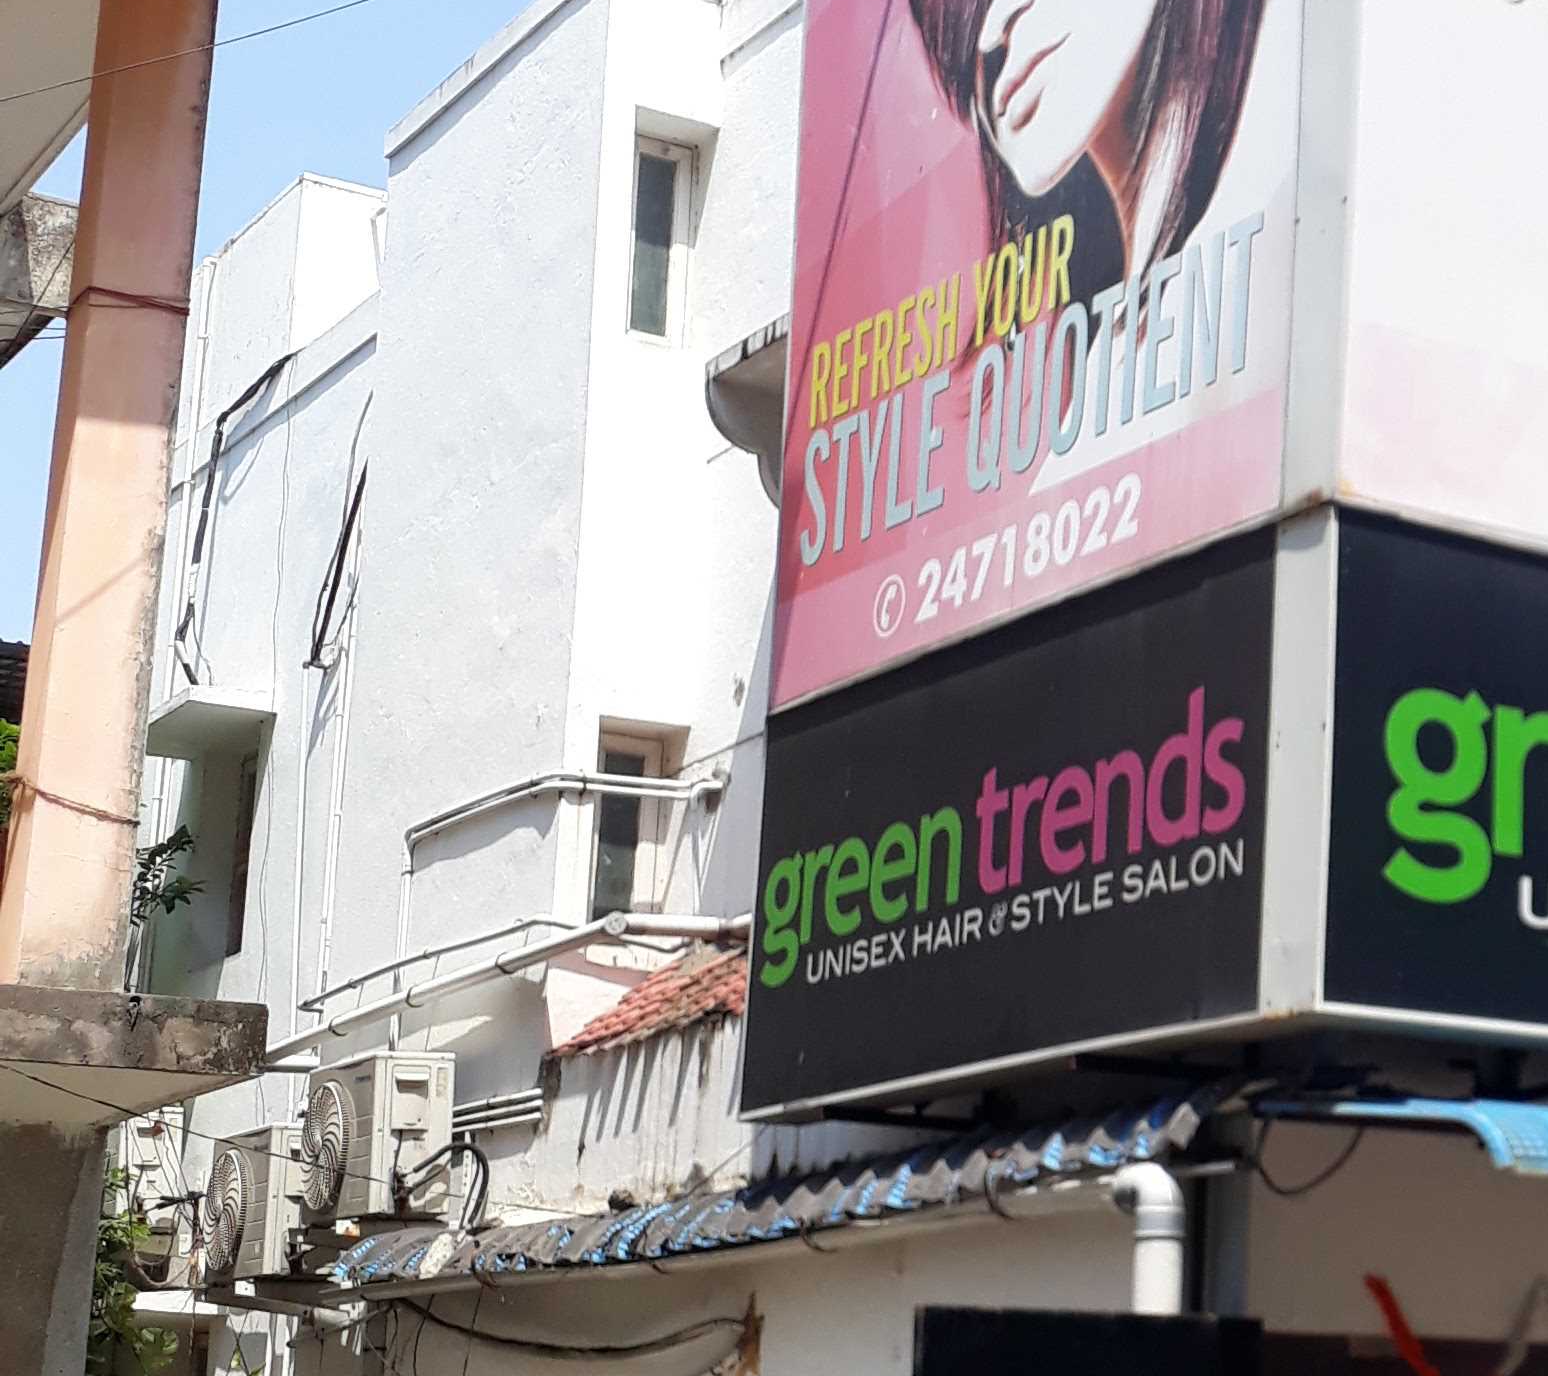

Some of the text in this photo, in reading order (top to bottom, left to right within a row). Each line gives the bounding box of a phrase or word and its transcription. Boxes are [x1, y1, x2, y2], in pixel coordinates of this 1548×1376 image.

[801, 211, 1265, 567] STYLE QUOTIENT
[809, 214, 1075, 430] REFRESH YOUR
[914, 472, 1143, 624] 24718022
[759, 686, 1246, 988] green trends
[805, 838, 1245, 984] UNISEX HAIR & STYLE SALON
